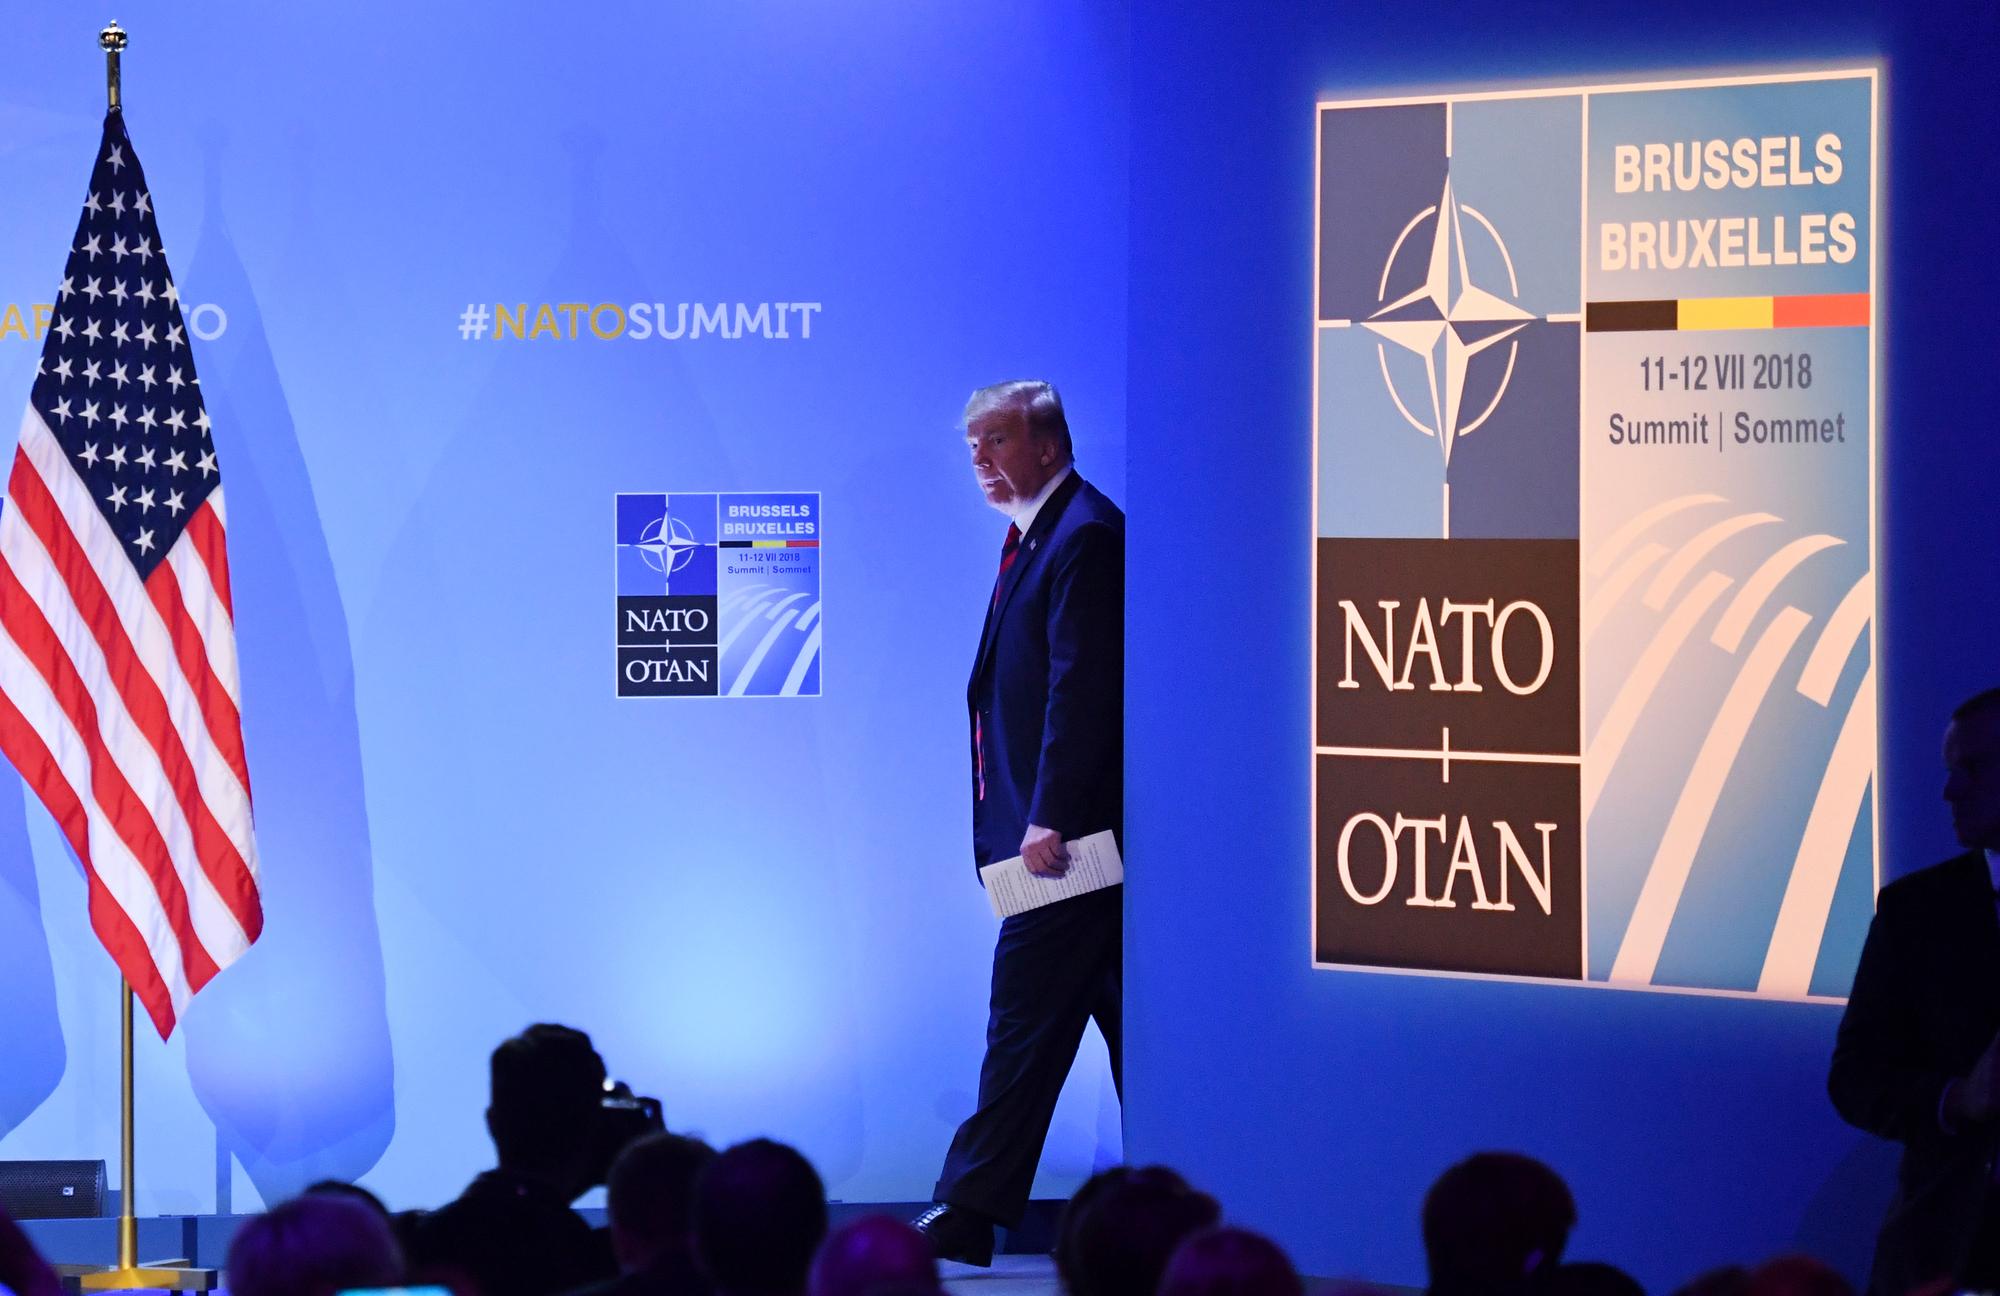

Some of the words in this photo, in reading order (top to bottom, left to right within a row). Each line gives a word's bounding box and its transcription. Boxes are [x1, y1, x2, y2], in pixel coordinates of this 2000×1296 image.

[1615, 133, 1843, 193] BRUSSELS
[1600, 213, 1857, 271] BRUXELLES
[458, 302, 822, 340] #NATOSUMMIT
[1641, 355, 1708, 391] 11-12
[1714, 354, 1745, 390] VII
[1753, 353, 1813, 390] 2018
[1609, 412, 1709, 445] Summit
[1734, 411, 1846, 444] Sommet
[728, 505, 810, 517] BRUSSELS
[723, 522, 815, 535] BRUXELLES
[727, 566, 764, 574] Summit
[772, 566, 812, 574] Sommet
[739, 553, 764, 562] 11-12
[765, 553, 777, 562] VII
[779, 553, 800, 562] 2018
[625, 609, 709, 632] NATO
[1337, 597, 1554, 696] NATO
[625, 659, 710, 683] OTAN
[1337, 812, 1558, 916] OTAN
